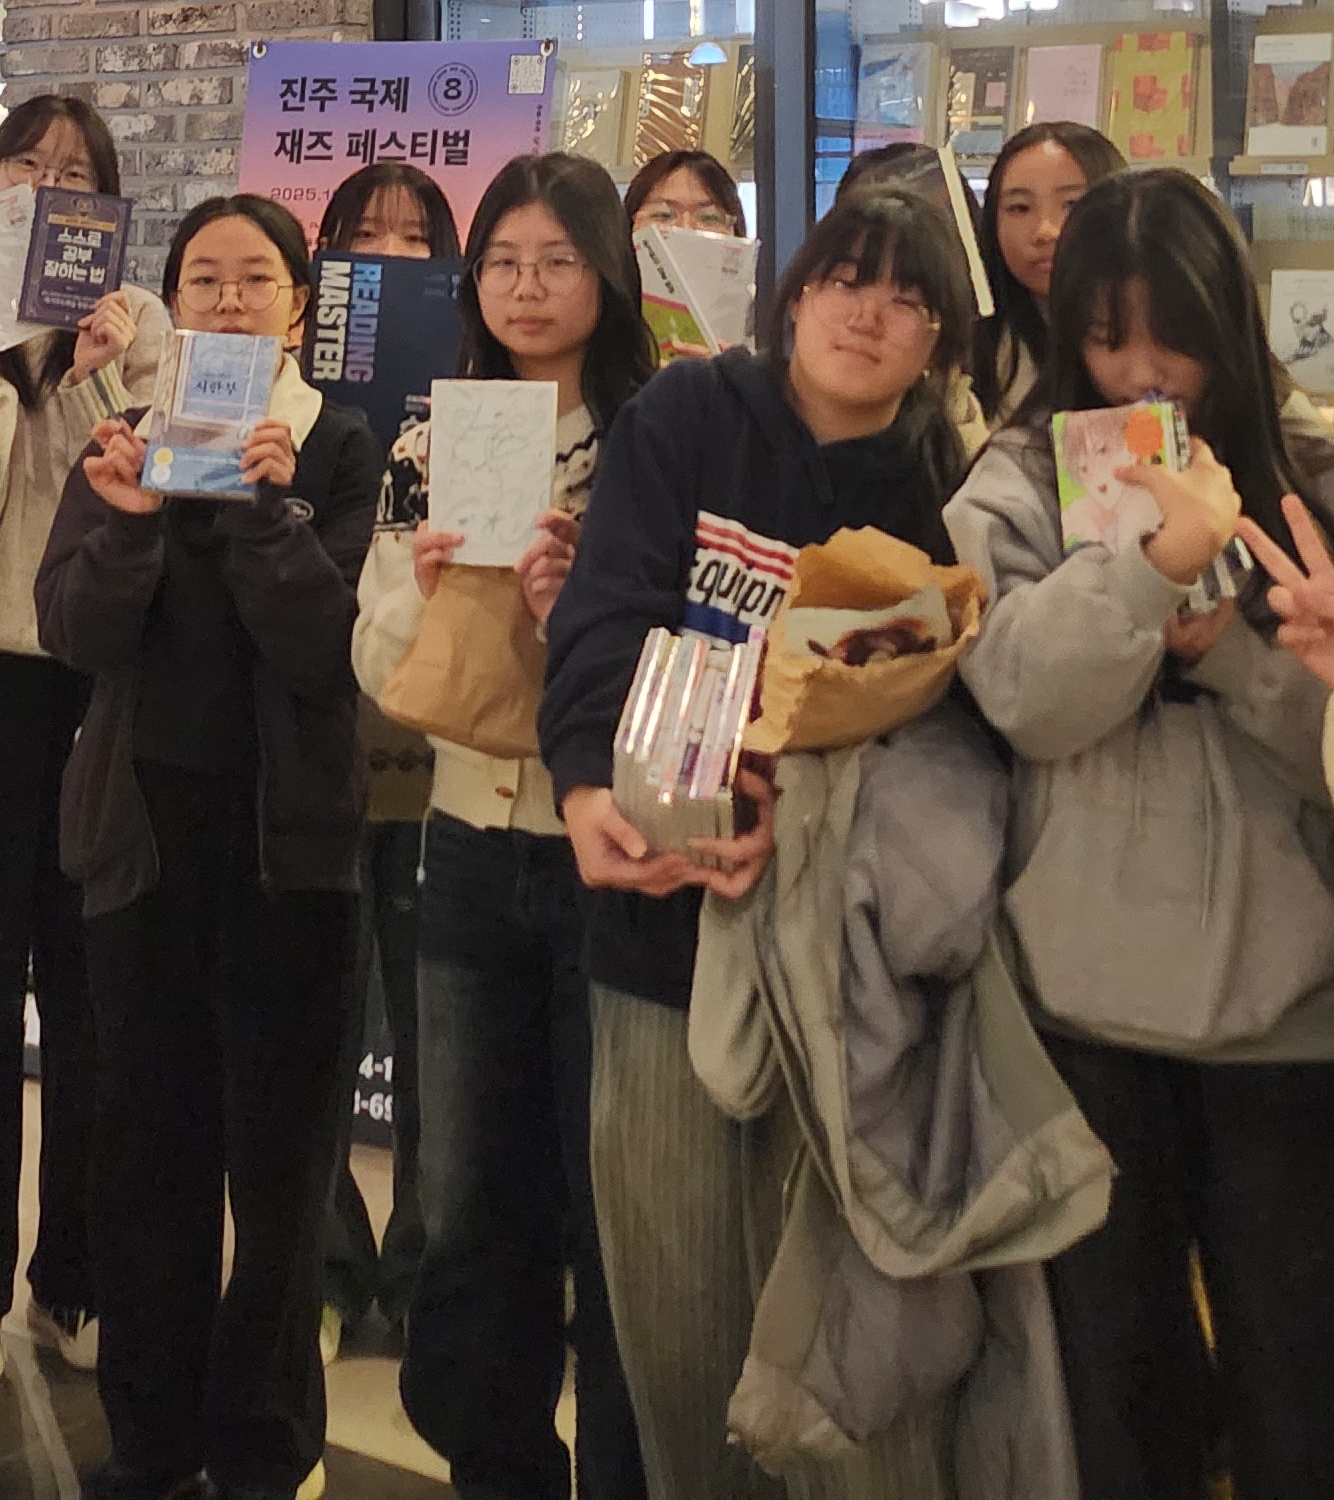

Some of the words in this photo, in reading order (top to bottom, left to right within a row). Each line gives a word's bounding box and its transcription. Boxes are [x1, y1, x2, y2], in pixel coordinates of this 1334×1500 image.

[278, 76, 339, 113] 진주
[348, 76, 410, 113] 국제
[443, 77, 462, 100] 8
[274, 127, 333, 165] 재즈
[345, 128, 471, 166] 페스티벌
[271, 187, 335, 202] 2025.1
[56, 227, 102, 248] 스스로
[62, 244, 93, 264] 공부
[43, 259, 88, 282] 잘하는
[89, 266, 106, 285] 법
[311, 259, 353, 383] MASTER
[345, 262, 383, 384] READING
